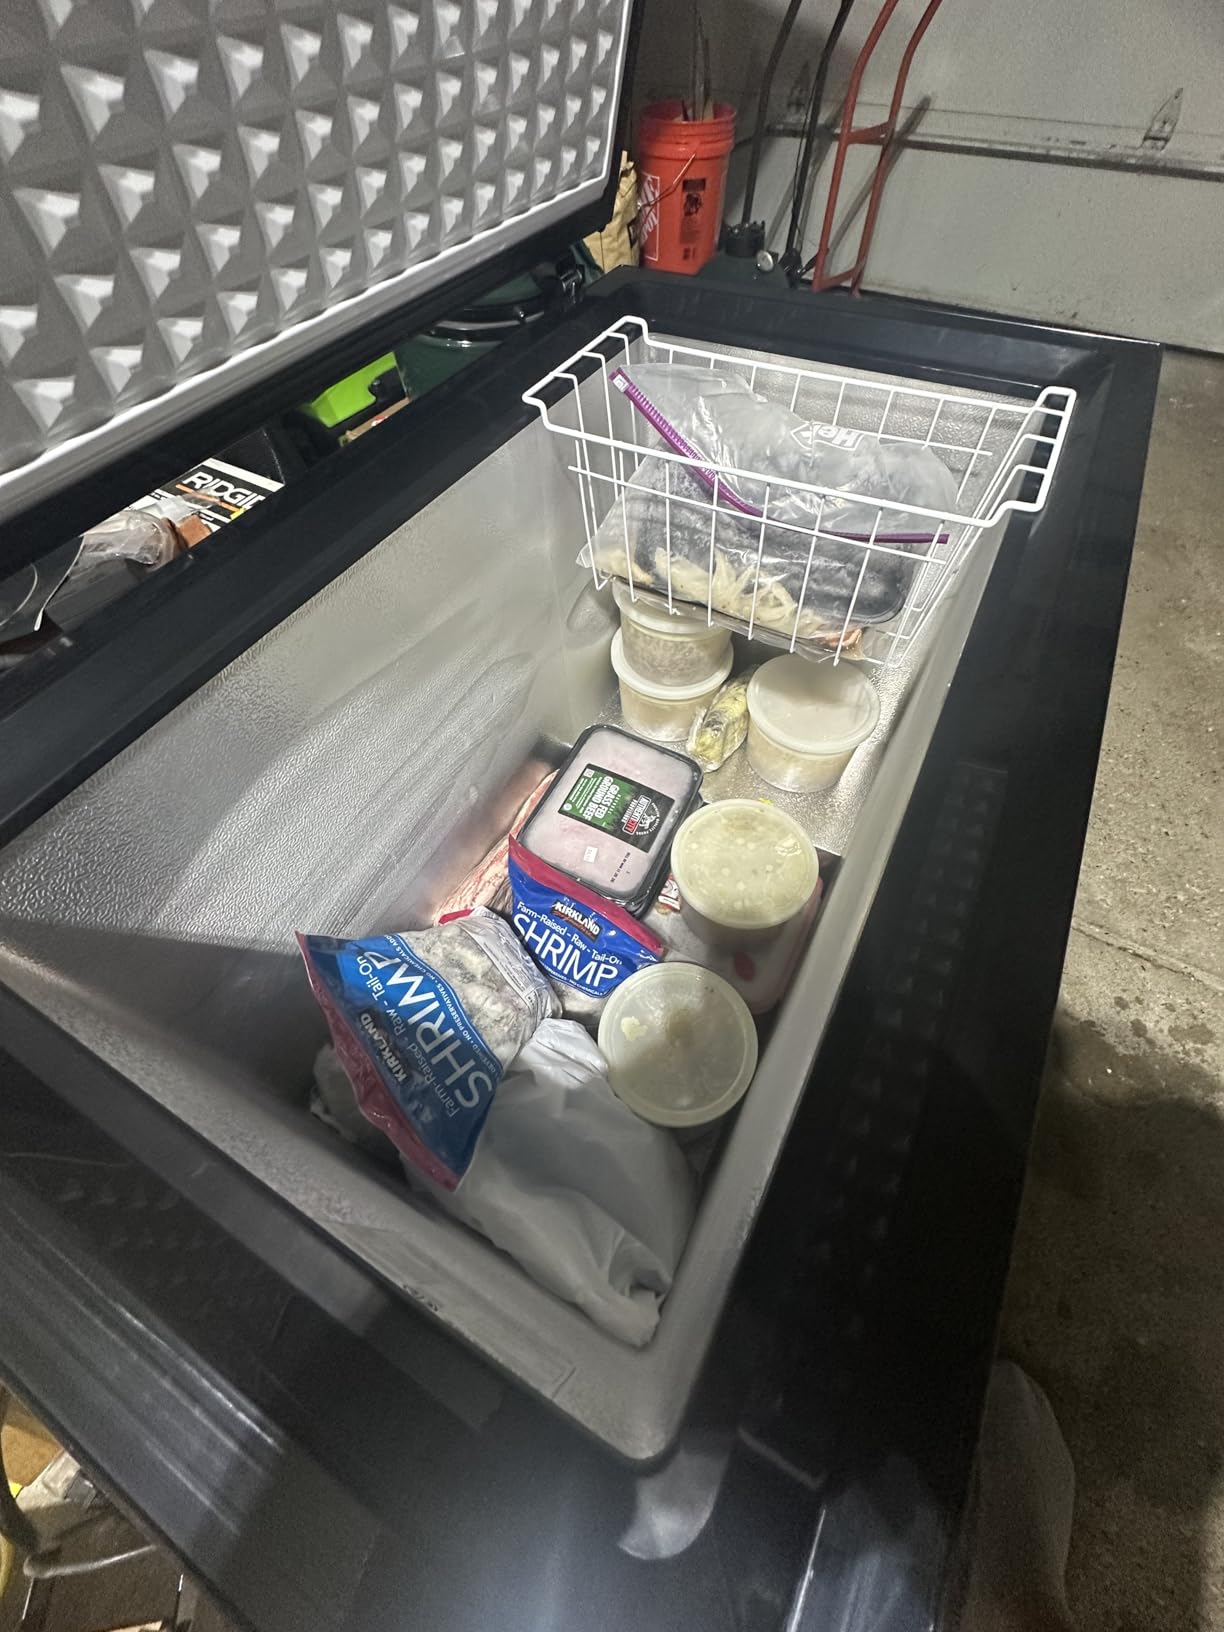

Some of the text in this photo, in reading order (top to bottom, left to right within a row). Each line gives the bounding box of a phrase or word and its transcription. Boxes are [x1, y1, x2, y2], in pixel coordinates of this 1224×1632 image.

[592, 776, 614, 803] GROUND
[594, 784, 619, 819] GRASS FED
[583, 802, 599, 821] BEEF
[516, 901, 567, 936] Farm-Raised
[572, 935, 587, 952] Raw
[591, 949, 622, 966] Tail-On
[554, 902, 600, 936] KIRKLAND
[395, 946, 426, 973] CHEMICALS
[513, 913, 618, 987] SHRIMP
[425, 972, 436, 981] NO
[436, 982, 464, 1031] PRESERVATIVES
[356, 956, 460, 1118] Farm-Raised Raw Tail-On
[363, 951, 492, 1108] SHRIMP
[462, 1030, 472, 1041] NO
[360, 1012, 409, 1086] KIRKLAND
